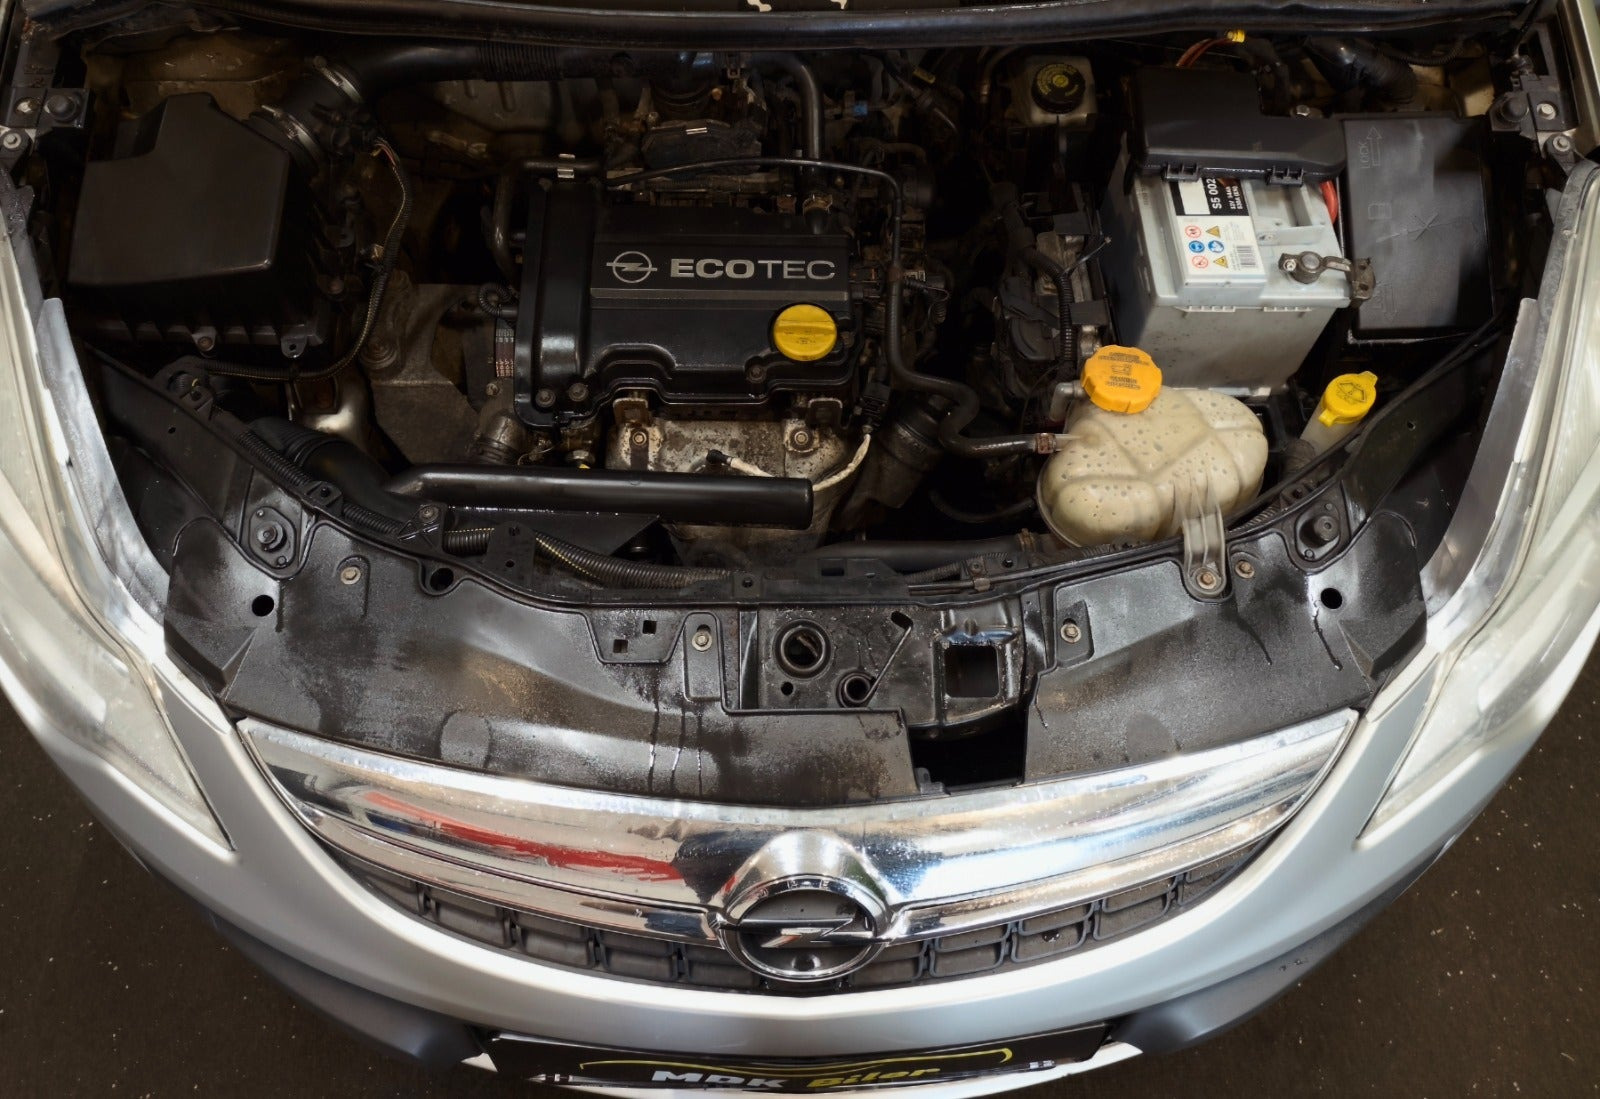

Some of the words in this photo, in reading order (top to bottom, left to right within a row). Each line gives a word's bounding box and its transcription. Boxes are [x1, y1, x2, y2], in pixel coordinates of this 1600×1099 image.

[1206, 178, 1219, 195] 002
[1211, 197, 1222, 209] S5
[670, 258, 836, 280] ECOTEC
[651, 1070, 788, 1088] MDK
